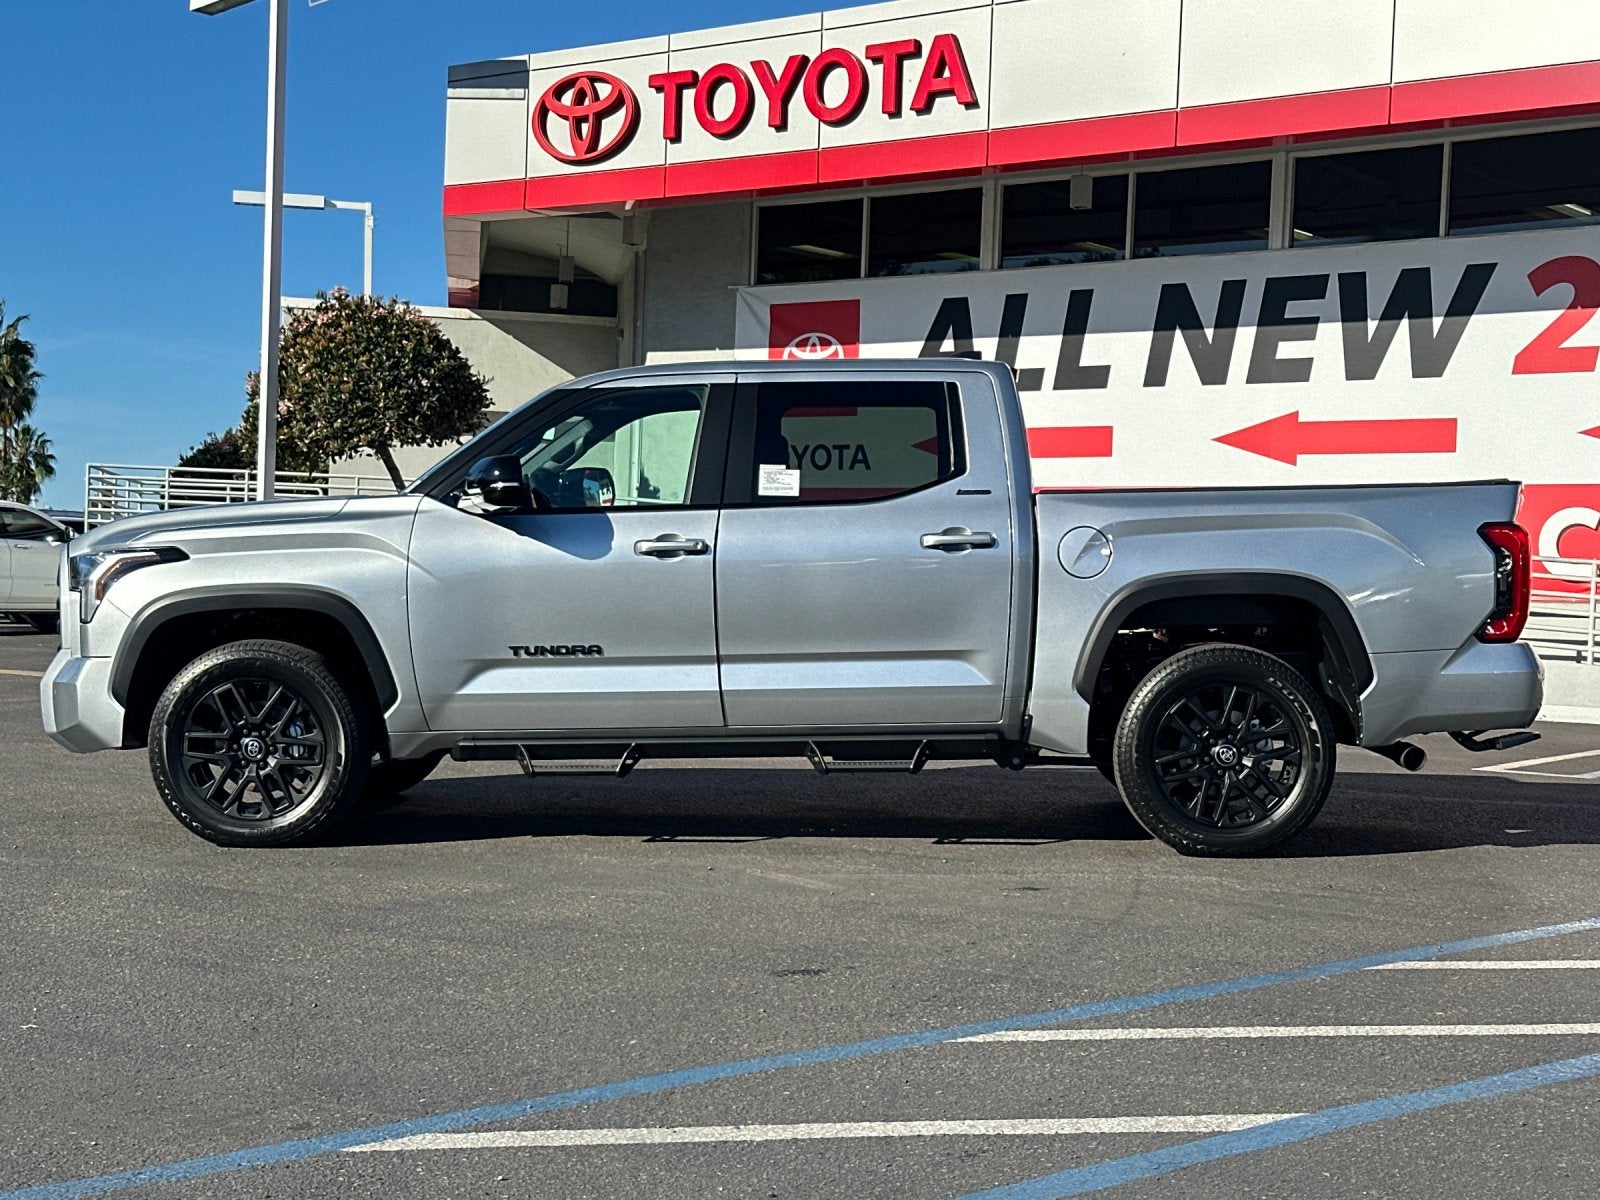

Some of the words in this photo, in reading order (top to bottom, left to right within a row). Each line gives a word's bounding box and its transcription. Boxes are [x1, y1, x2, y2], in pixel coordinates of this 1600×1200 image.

[649, 33, 979, 143] TOYOTA
[918, 288, 1111, 391] ALL
[1142, 262, 1498, 388] NEW
[790, 443, 871, 471] YOTA
[508, 644, 604, 657] TUNDRA
